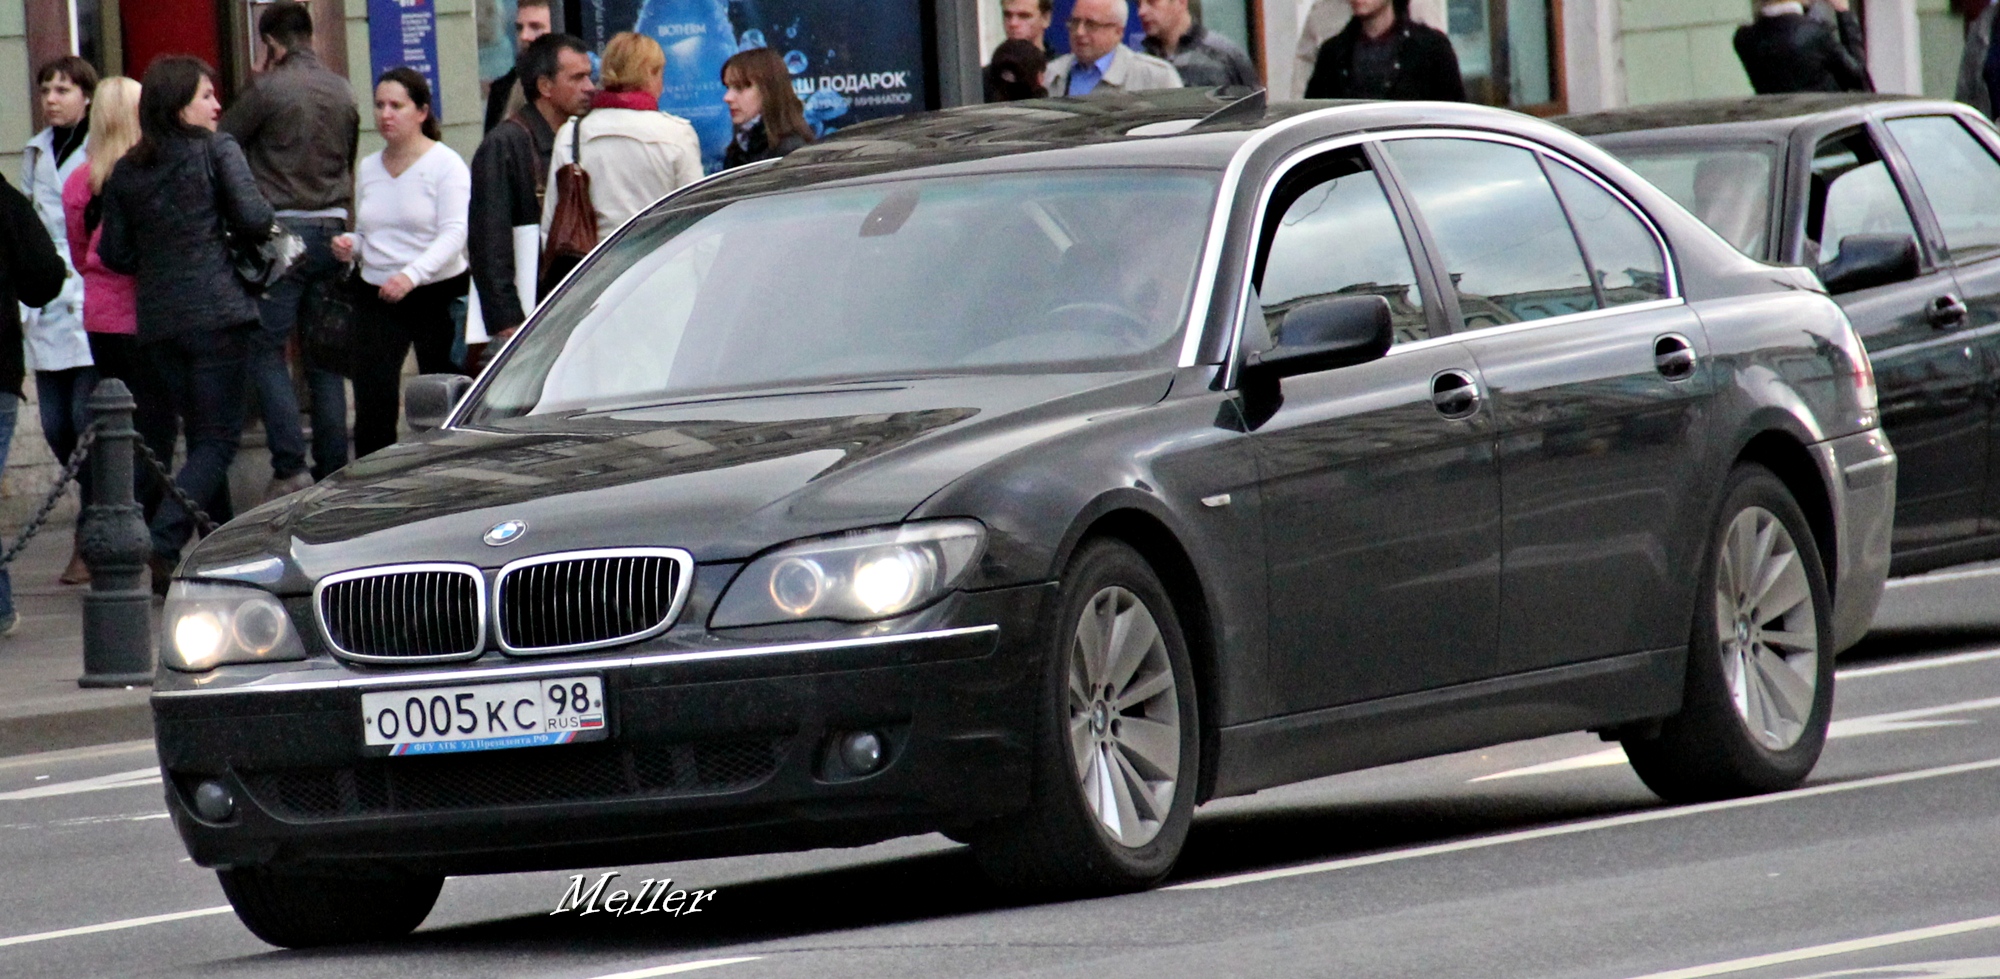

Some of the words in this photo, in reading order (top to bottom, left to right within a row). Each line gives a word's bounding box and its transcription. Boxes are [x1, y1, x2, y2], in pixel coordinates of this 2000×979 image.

[548, 682, 590, 715] 98
[548, 716, 579, 730] RUS
[414, 742, 434, 751] ФГУ
[476, 737, 531, 749] Президента
[533, 734, 549, 743] РФ
